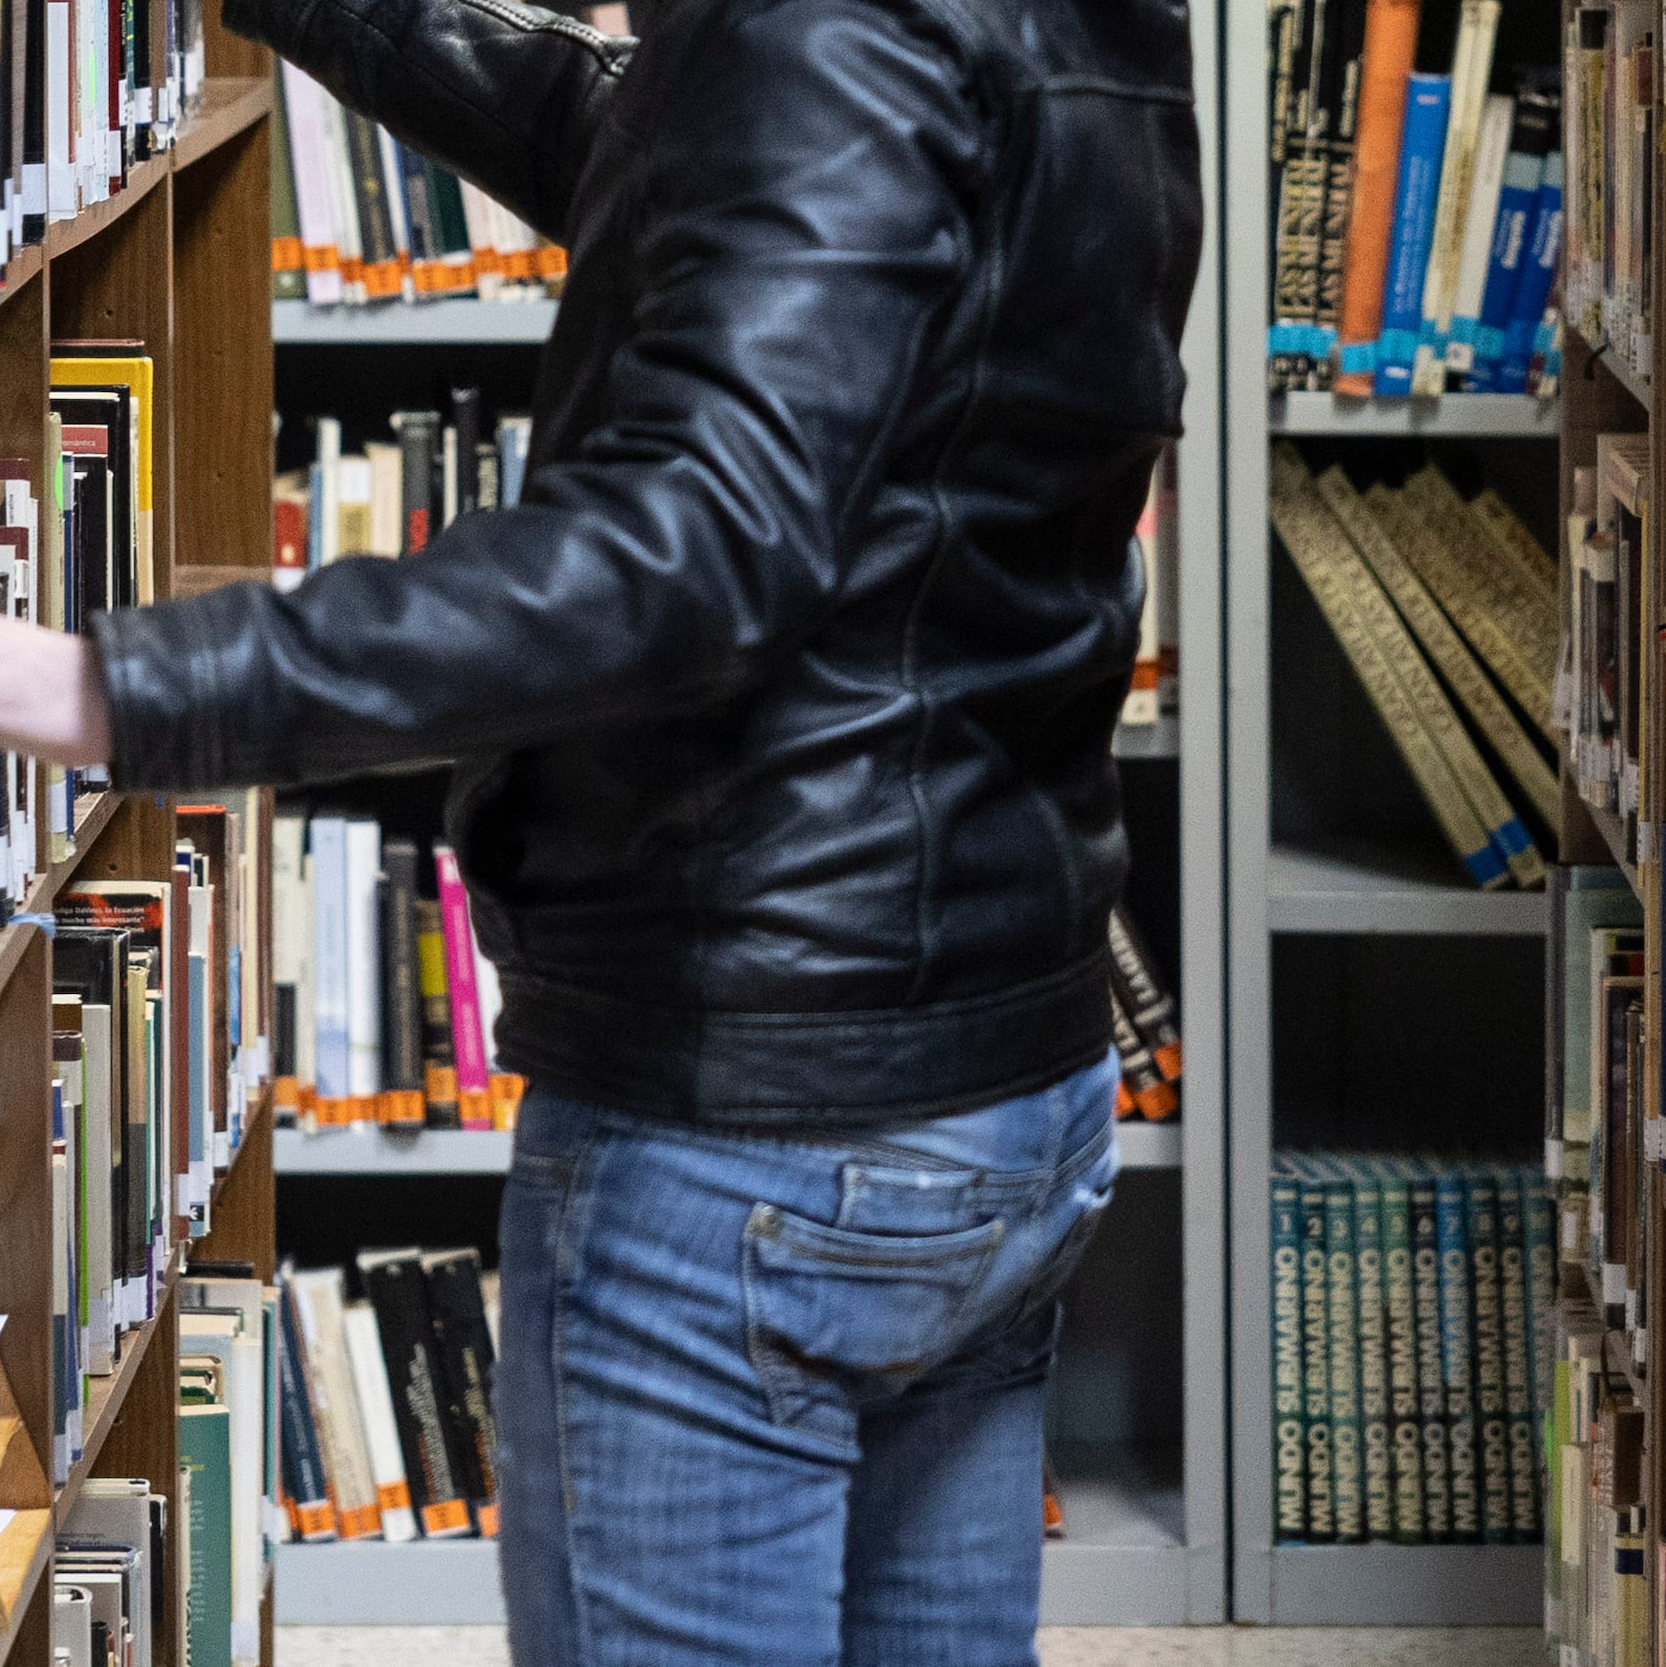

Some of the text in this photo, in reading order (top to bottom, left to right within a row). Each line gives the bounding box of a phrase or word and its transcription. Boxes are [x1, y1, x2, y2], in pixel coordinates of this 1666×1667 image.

[62, 439, 96, 447] omántica
[1280, 1213, 1291, 1233] 1
[1308, 1216, 1323, 1237] 2
[1363, 1215, 1377, 1236] 4
[1418, 1215, 1434, 1236] 6
[1446, 1215, 1461, 1234] 7
[1505, 1215, 1520, 1233] 9
[1276, 1246, 1303, 1529] MUNDO SUBMARINO
[1304, 1250, 1332, 1531] MUNDO SUBMARINO
[1330, 1251, 1359, 1534] MUNDO SUBMARINO
[1359, 1249, 1389, 1531] MUNDO SUBMARINO
[1388, 1248, 1420, 1531] MUNDO SUBMARINO
[1416, 1248, 1447, 1531] MUNDO SUBMARINO
[1444, 1249, 1475, 1531] MUNDO SUBMARINO
[1474, 1246, 1507, 1528] MUNDO SUBMARINO
[1502, 1247, 1535, 1528] MUNDO SUBMARINO
